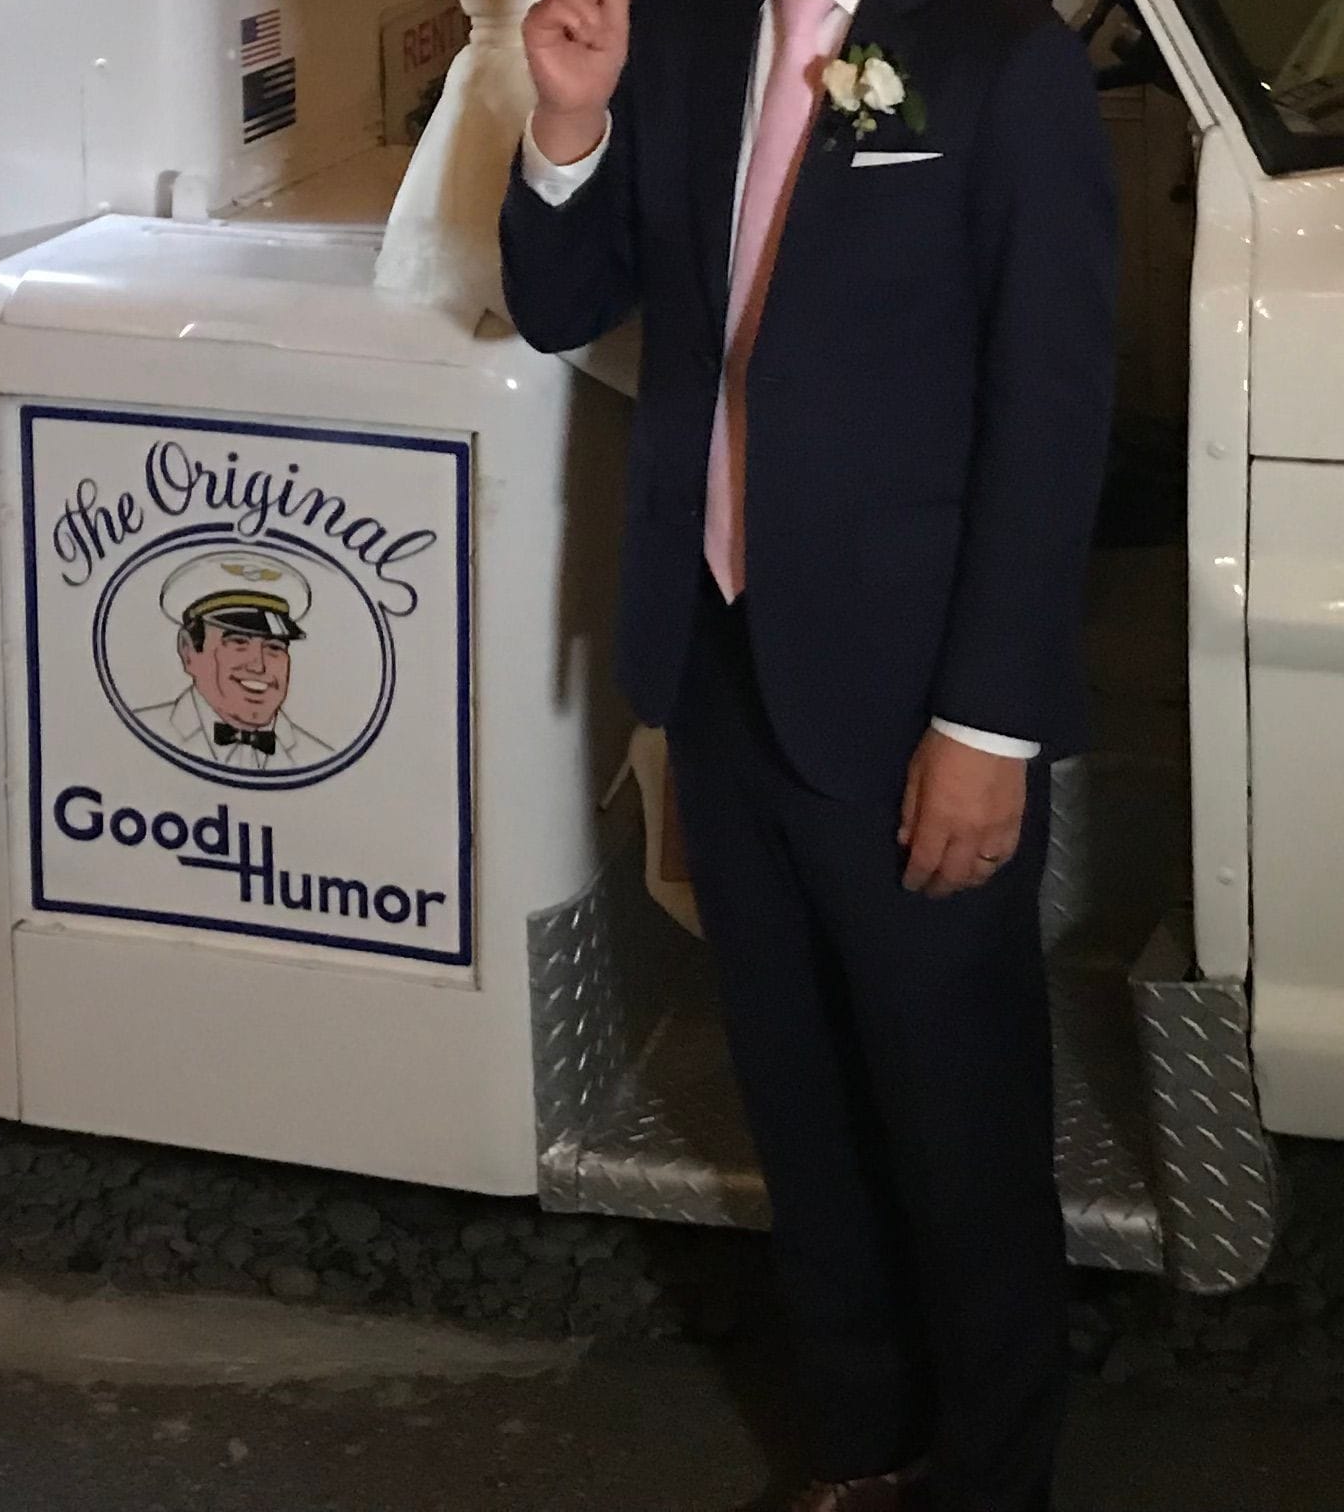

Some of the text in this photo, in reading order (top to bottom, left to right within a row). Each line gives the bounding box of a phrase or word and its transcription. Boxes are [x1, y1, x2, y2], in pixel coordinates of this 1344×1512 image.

[53, 439, 438, 617] The Original
[52, 785, 230, 857] Good
[228, 821, 447, 928] Humor
